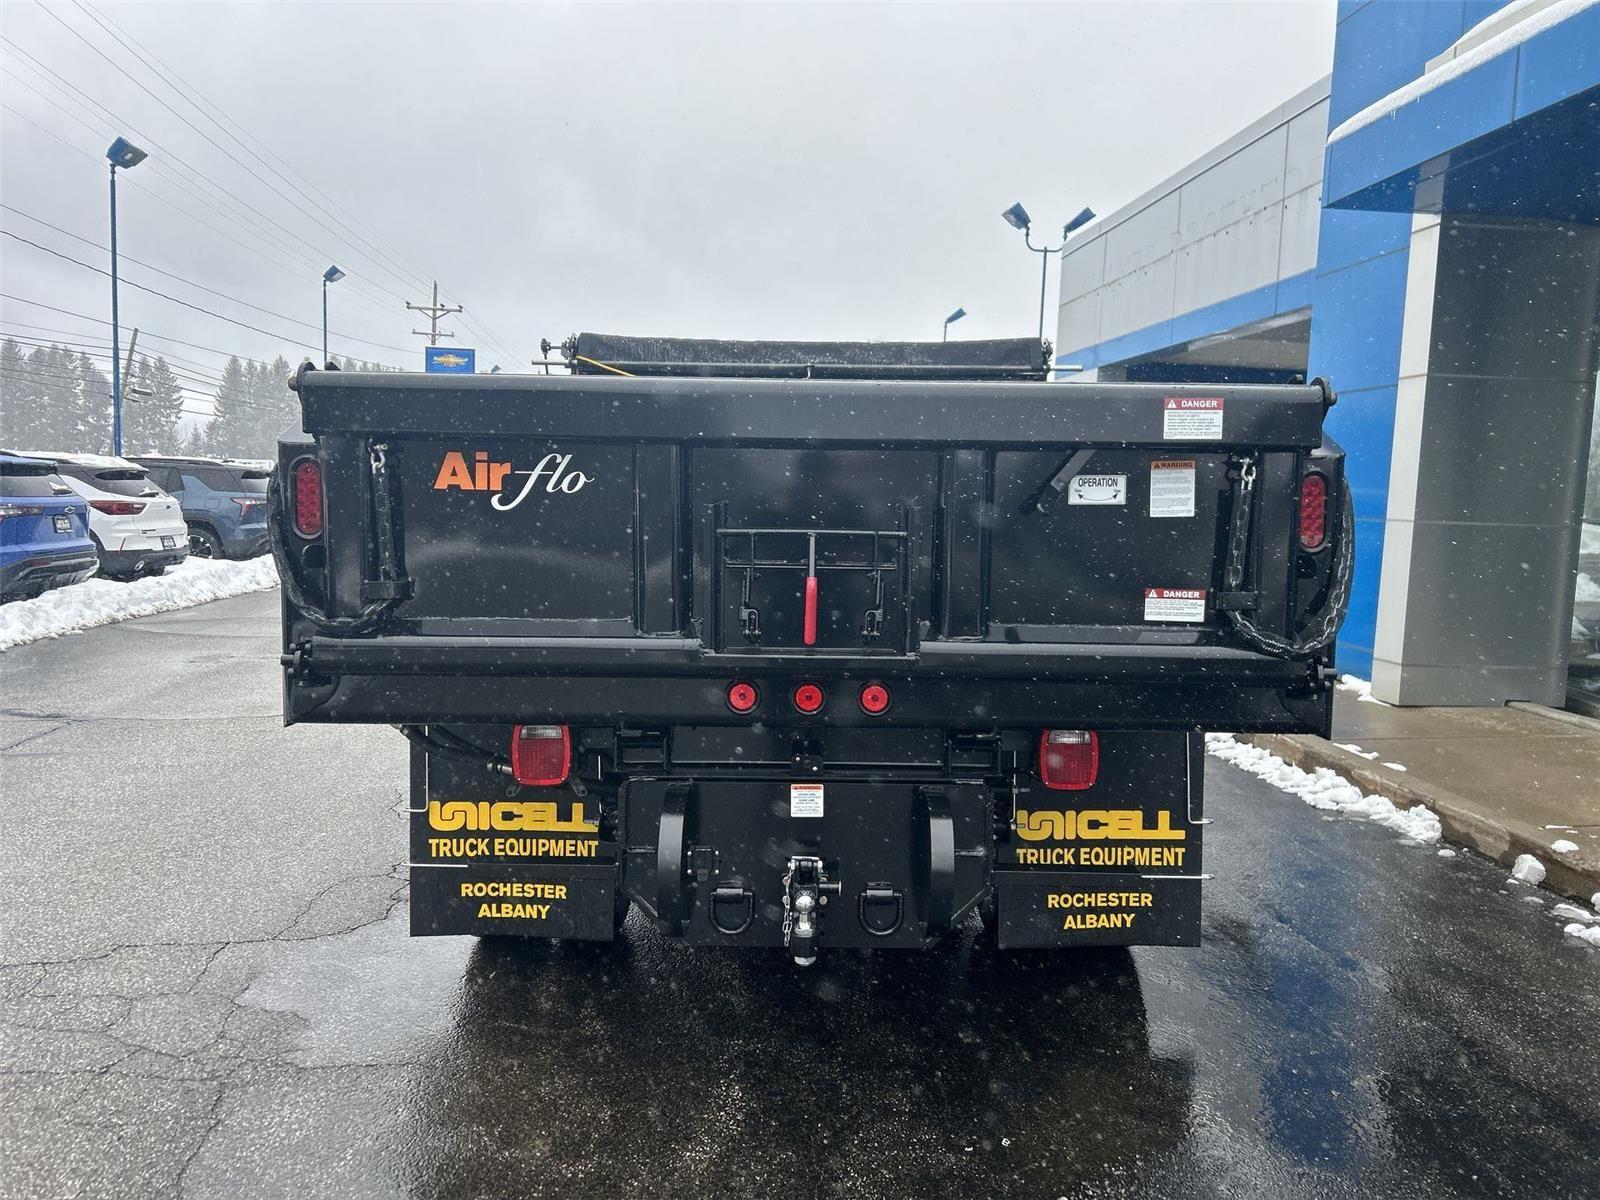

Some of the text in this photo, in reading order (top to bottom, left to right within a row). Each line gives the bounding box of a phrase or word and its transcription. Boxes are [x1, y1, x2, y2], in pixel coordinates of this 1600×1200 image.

[1181, 400, 1218, 408] DANGER
[1078, 477, 1118, 487] OPERATION
[1163, 590, 1200, 598] DANGER
[428, 800, 599, 832] UNICELL
[1016, 809, 1186, 840] UNICELL
[428, 838, 599, 857] TRUCK EQUIPMENT
[1016, 847, 1186, 866] TRUCK EQUIPMENT
[461, 883, 567, 899] ROCHESTER
[1047, 892, 1153, 909] ROCHESTER
[477, 903, 551, 919] ALBANY
[1063, 913, 1136, 930] ALBANY
